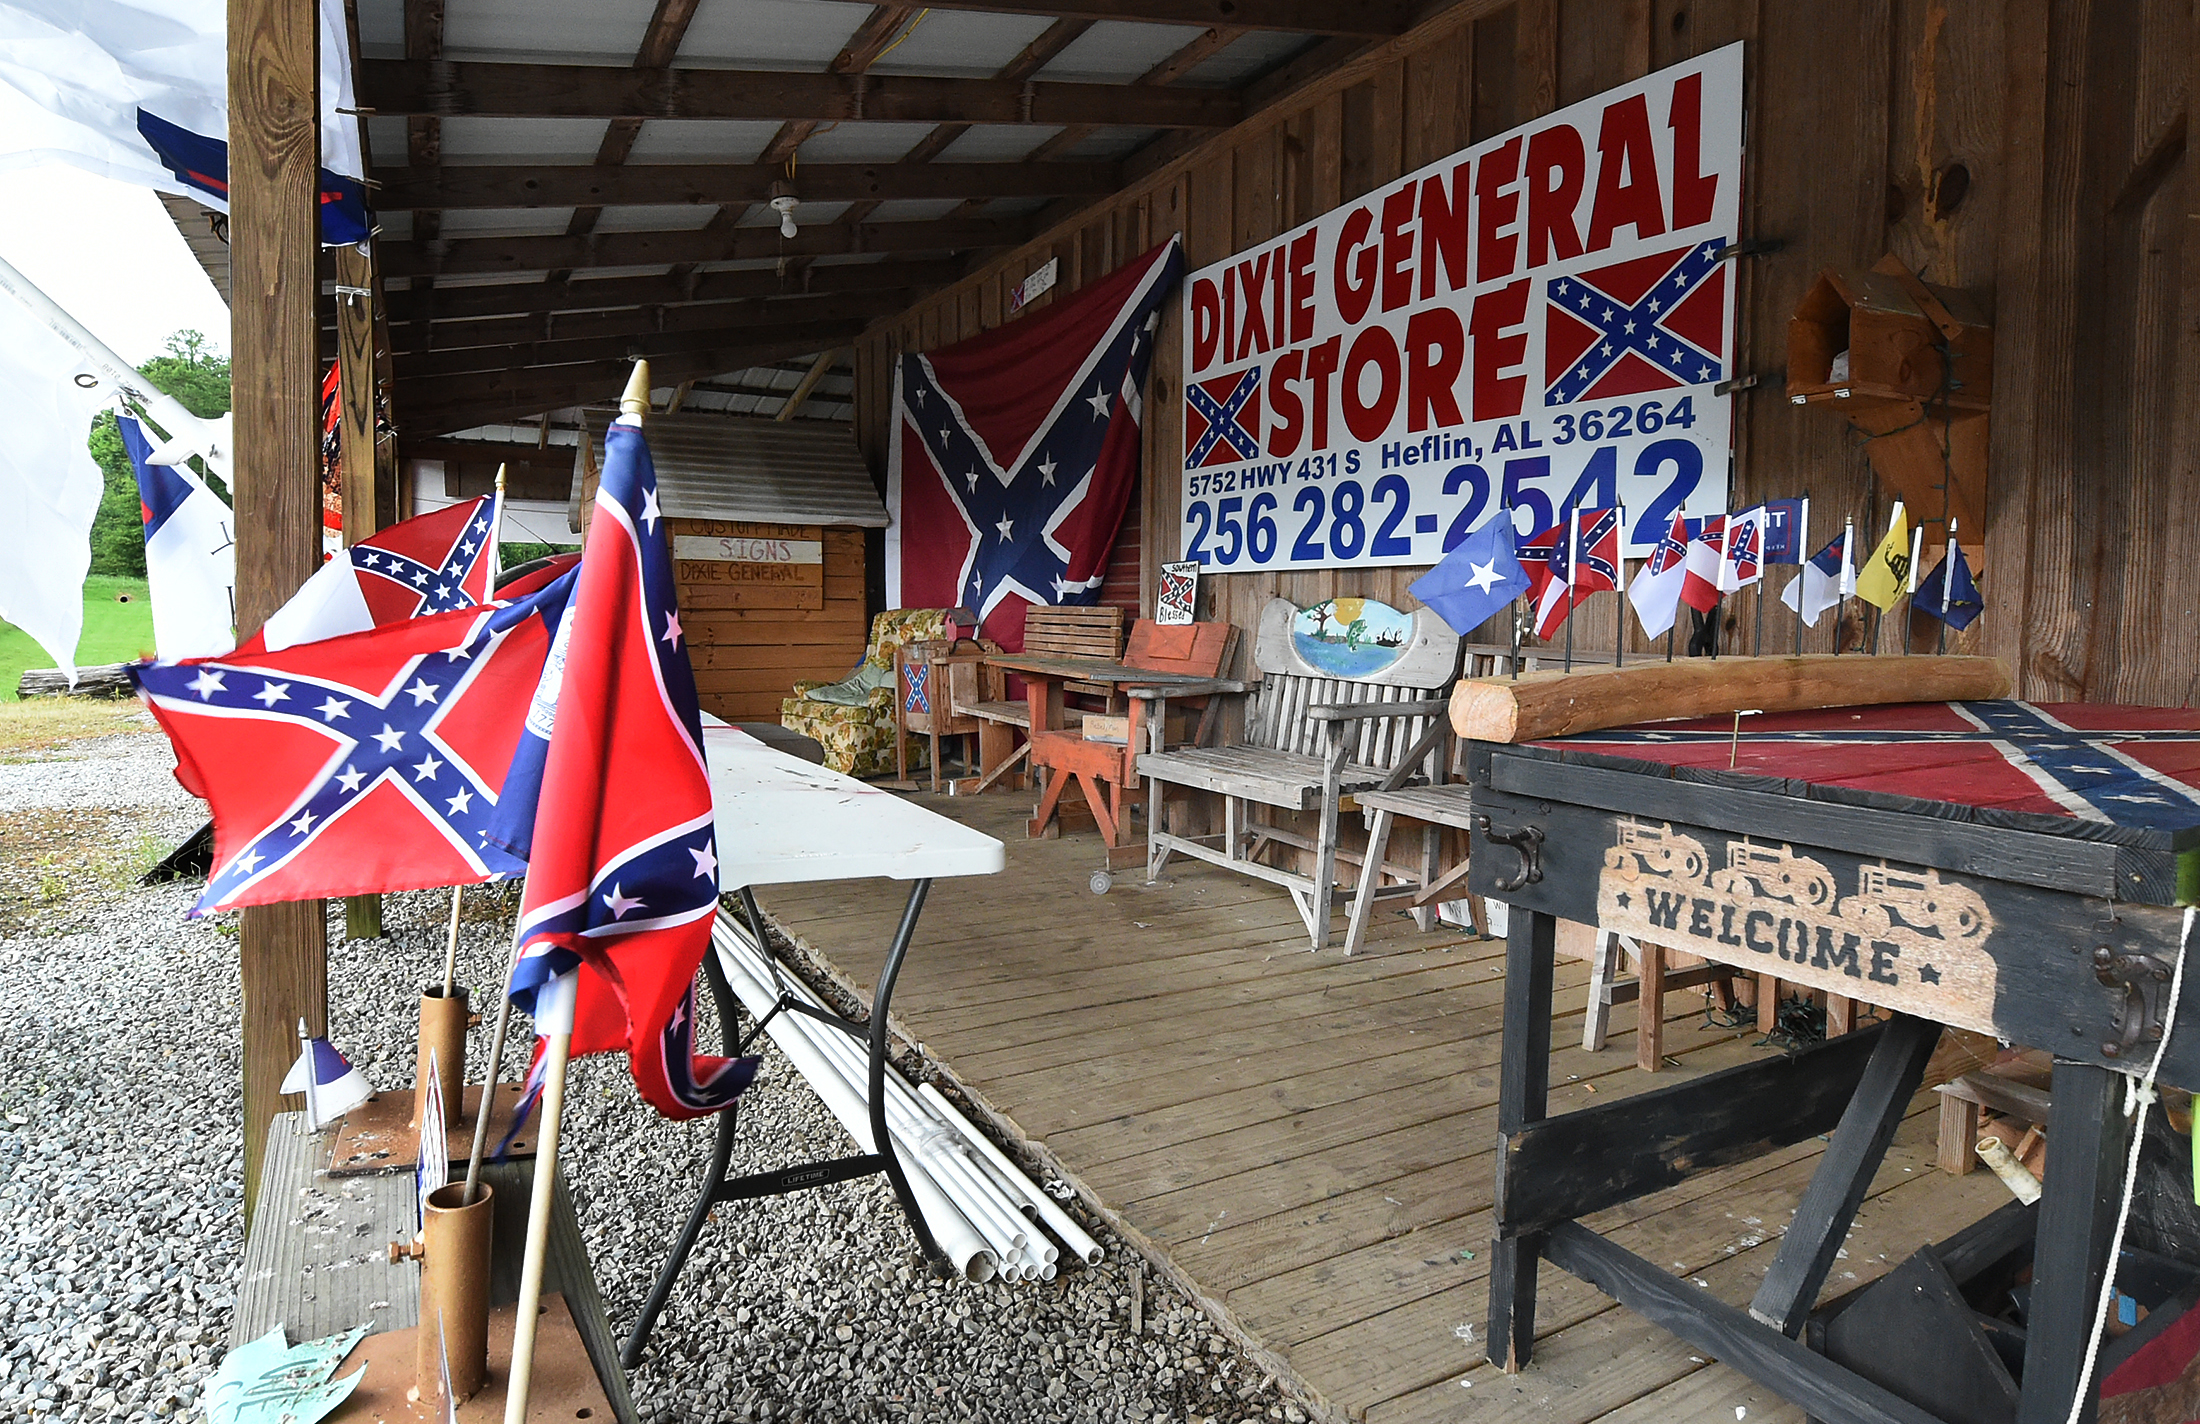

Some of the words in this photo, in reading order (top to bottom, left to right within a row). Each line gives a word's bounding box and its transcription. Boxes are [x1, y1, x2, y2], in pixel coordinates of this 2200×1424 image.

[1191, 226, 1317, 373] DIXIE
[1334, 72, 1718, 325] GENERAL
[1268, 277, 1532, 459] STORE
[1189, 470, 1236, 497] 5752
[1241, 461, 1292, 490] HWY
[1297, 453, 1337, 481] 431
[1345, 449, 1361, 475] S
[1382, 432, 1482, 469] Heflin,
[1491, 420, 1542, 453] AL
[1552, 396, 1696, 446] 36264
[719, 539, 792, 561] SIGNS
[1186, 492, 1278, 566] 256
[1290, 438, 1704, 562] 282-2542
[680, 562, 721, 581] DIXIE
[728, 563, 805, 582] GENERAL
[1644, 887, 1901, 987] WELCOME
[787, 1171, 824, 1184] LIFETIME
